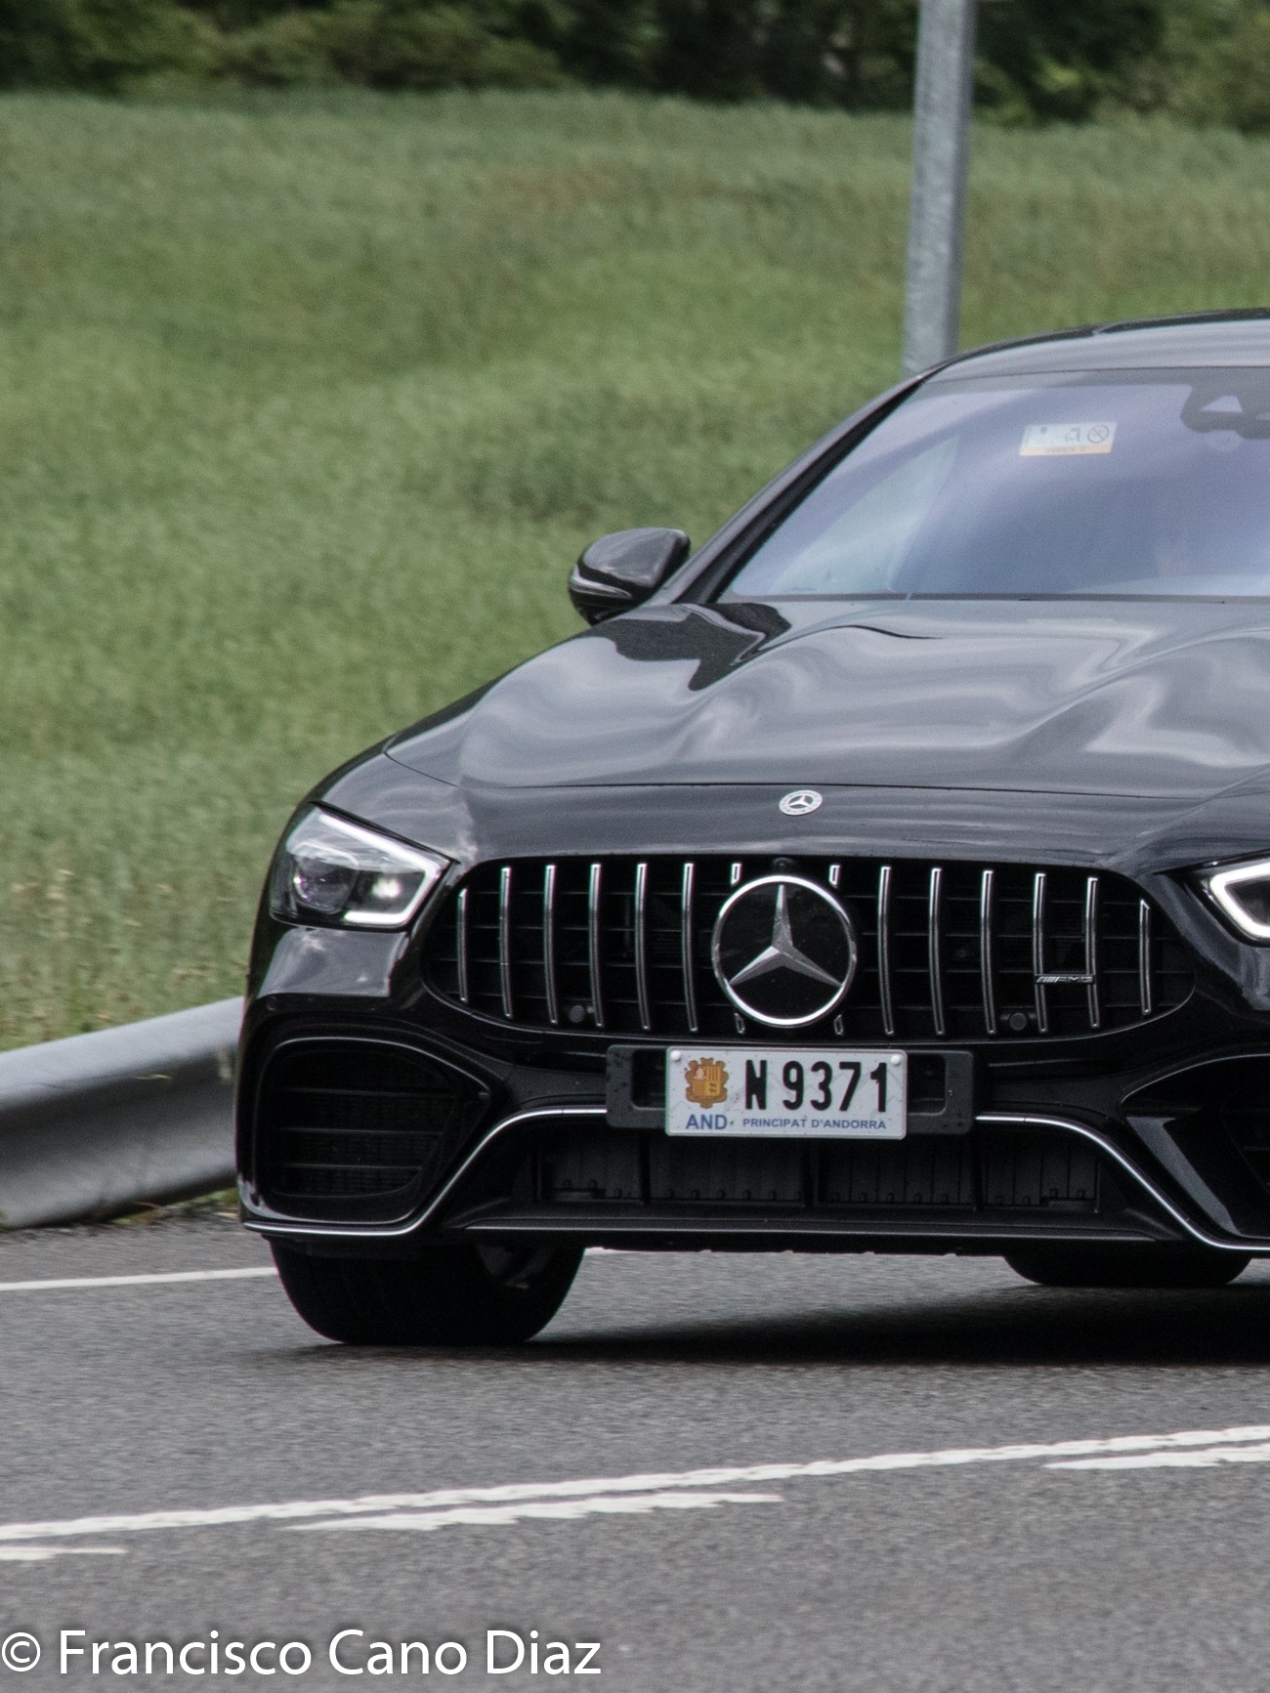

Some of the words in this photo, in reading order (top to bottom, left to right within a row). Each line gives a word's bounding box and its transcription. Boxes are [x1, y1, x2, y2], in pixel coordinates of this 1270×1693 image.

[745, 1059, 767, 1110] N
[782, 1060, 887, 1113] 9371
[685, 1113, 728, 1131] AND
[742, 1117, 808, 1129] PRINCIPAT
[811, 1118, 887, 1130] D'ANDORRA
